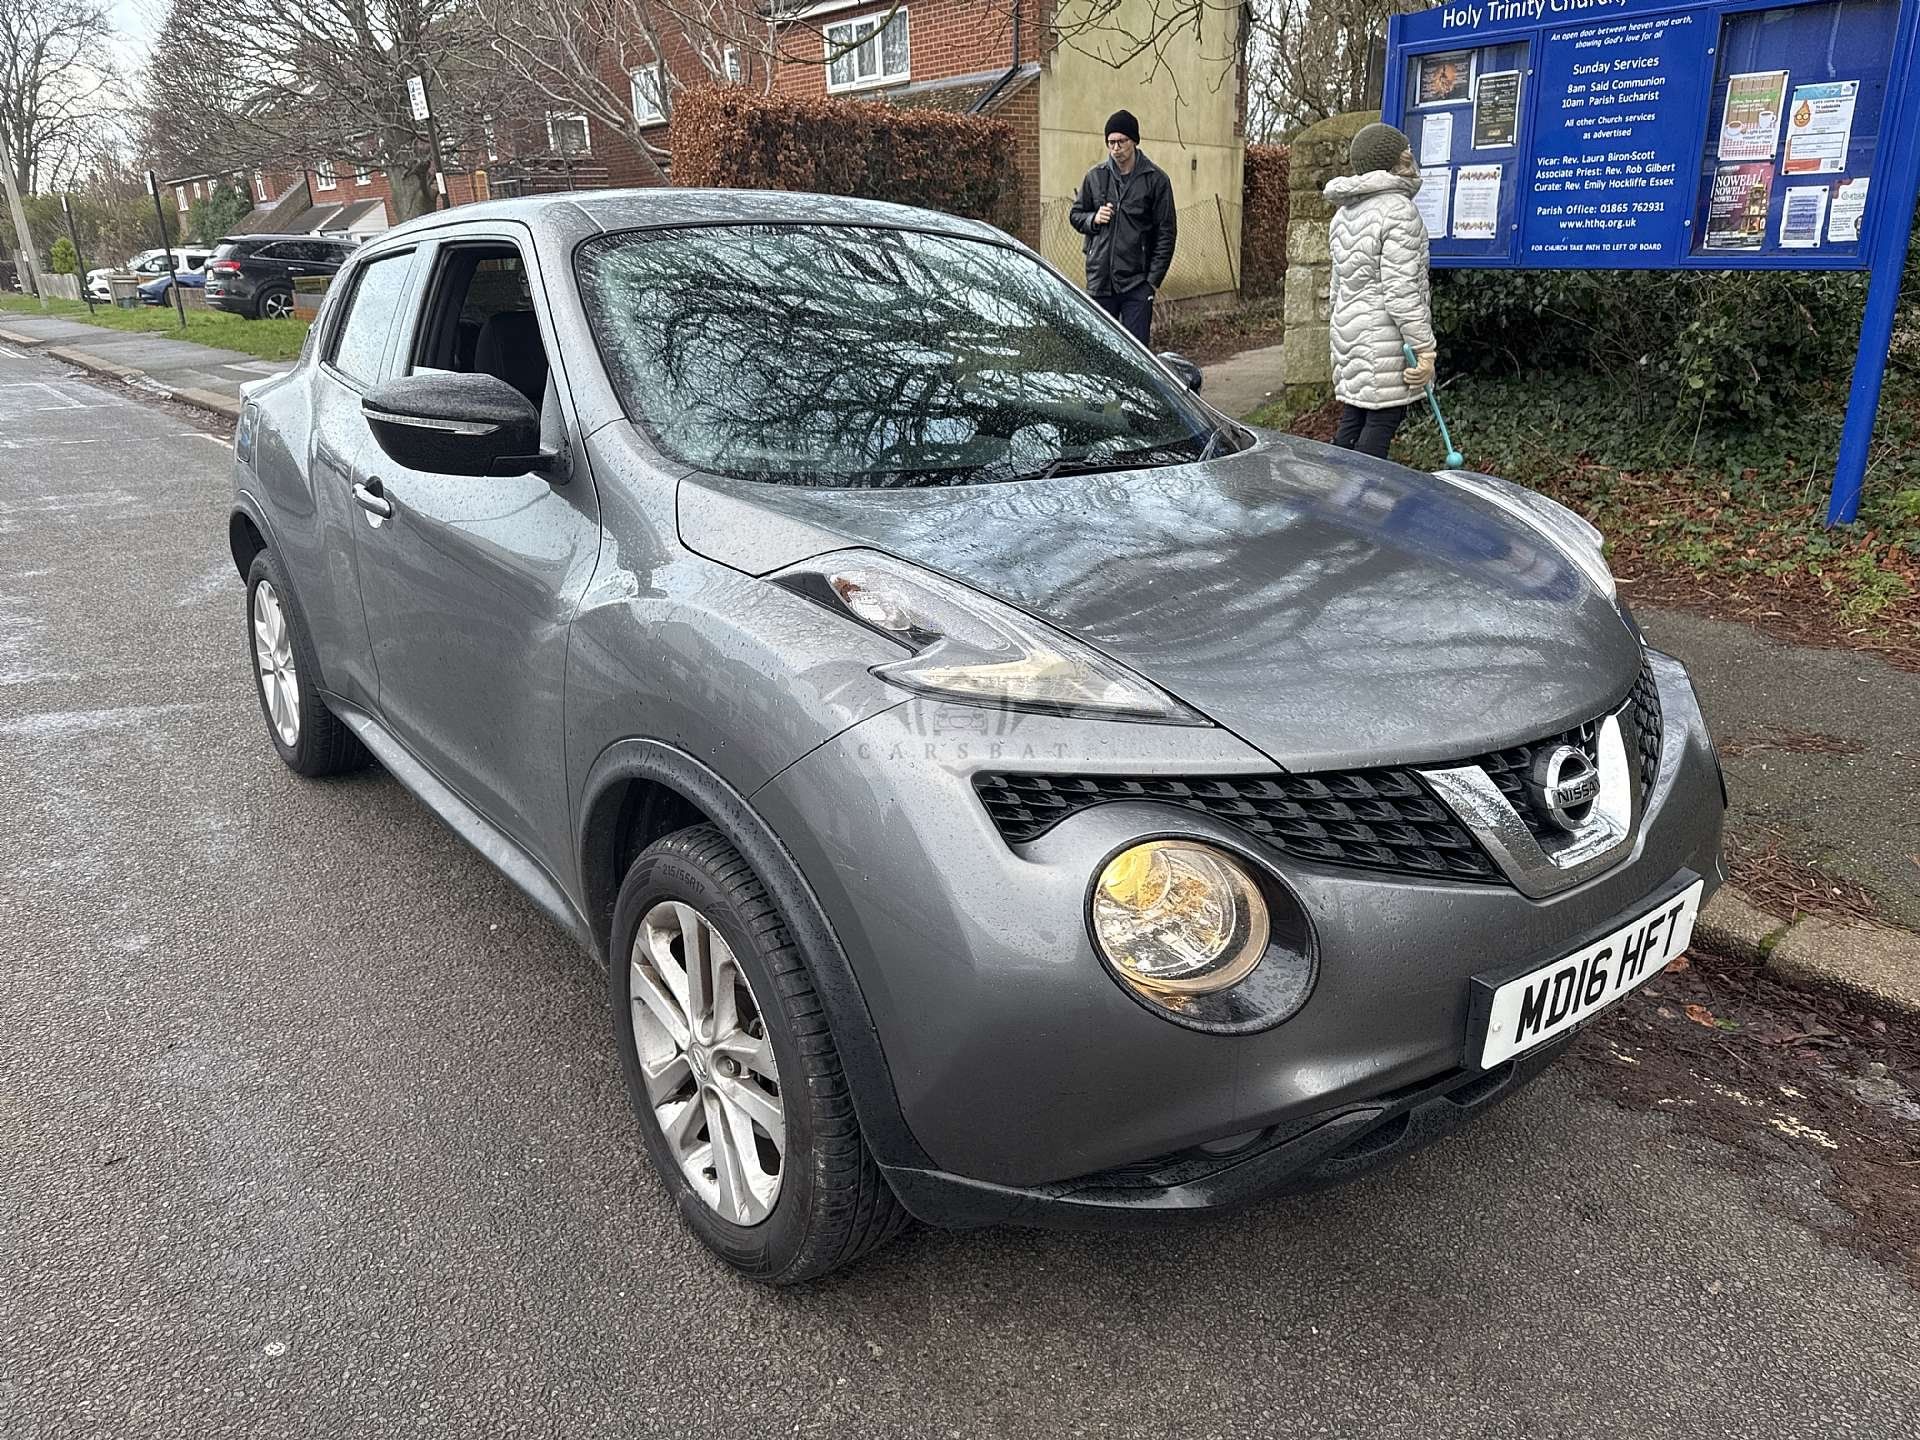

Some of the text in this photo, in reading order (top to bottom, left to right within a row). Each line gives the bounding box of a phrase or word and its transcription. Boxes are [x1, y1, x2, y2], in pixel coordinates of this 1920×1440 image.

[1443, 4, 1483, 29] Holy
[1487, 0, 1546, 20] Trinity
[1550, 33, 1561, 41] An
[1562, 32, 1579, 42] open
[1580, 29, 1596, 38] door
[1597, 25, 1627, 36] between
[1628, 22, 1654, 32] heaven
[1655, 18, 1670, 28] and
[1574, 38, 1603, 49] showing
[1625, 33, 1640, 42] love
[1640, 31, 1652, 42] for
[1654, 29, 1664, 39] all
[1572, 56, 1660, 76] Sunday Services
[1567, 76, 1667, 94] 8am Said Communion
[1561, 90, 1660, 109] 10am Parish Eucharist
[1564, 112, 1656, 128] All other Church services
[1582, 127, 1632, 140] as advertised
[1537, 150, 1656, 167] Vicar: Rev. Laura Biron-Scott
[1535, 162, 1676, 180] Associate Priest: Rev. Rob Gilbert
[1534, 177, 1674, 192] Curate: Rev. Emily Hockliffe Essex
[1536, 202, 1665, 216] Parish Office: 01865 762931
[1559, 217, 1637, 230] www.hthq.org.uk
[1531, 243, 1662, 252] FOR CHURCH TAKE PATH TO LEFT OF BOARD
[1514, 900, 1686, 1045] MD16 HFT
